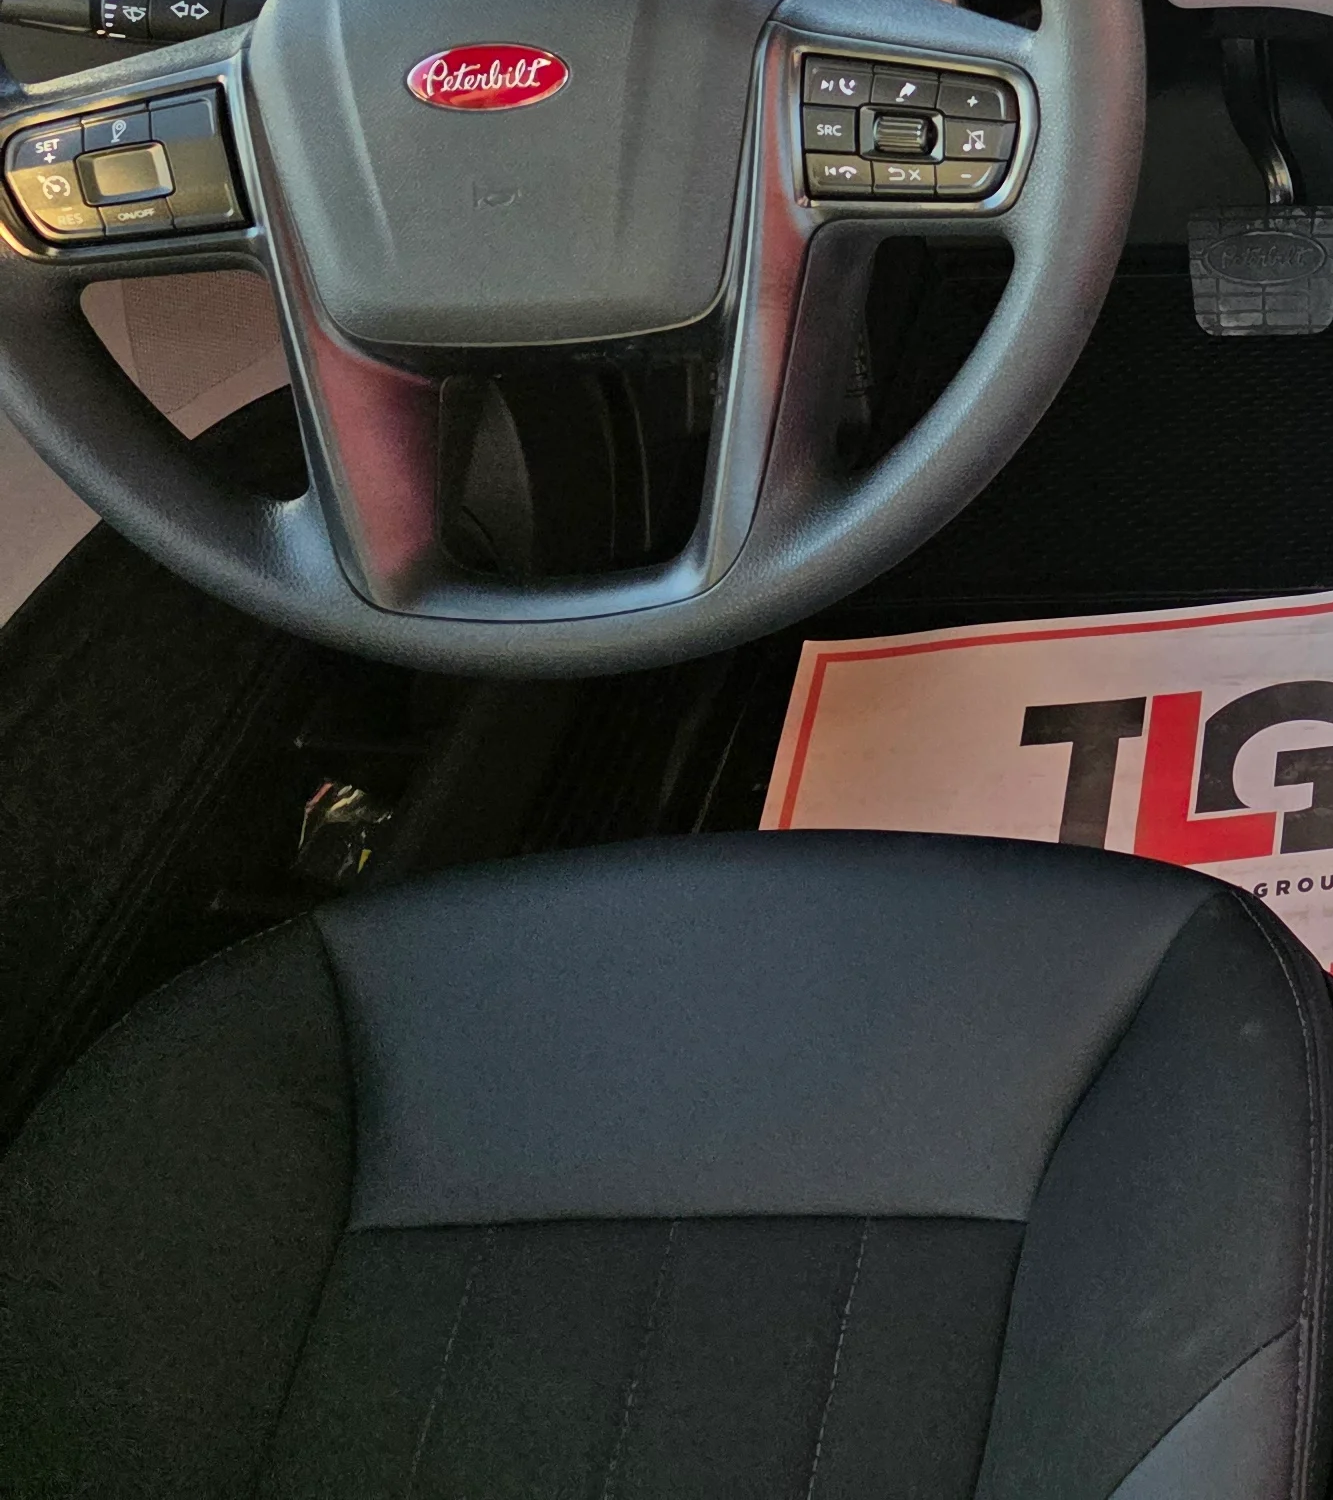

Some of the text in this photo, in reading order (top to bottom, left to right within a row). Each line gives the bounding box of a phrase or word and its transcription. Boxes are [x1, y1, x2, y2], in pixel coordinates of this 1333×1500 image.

[423, 58, 551, 98] Peterbilt
[815, 123, 842, 138] SRC
[35, 138, 60, 154] SET
[57, 213, 84, 226] RES
[117, 207, 156, 221] ON/OFF
